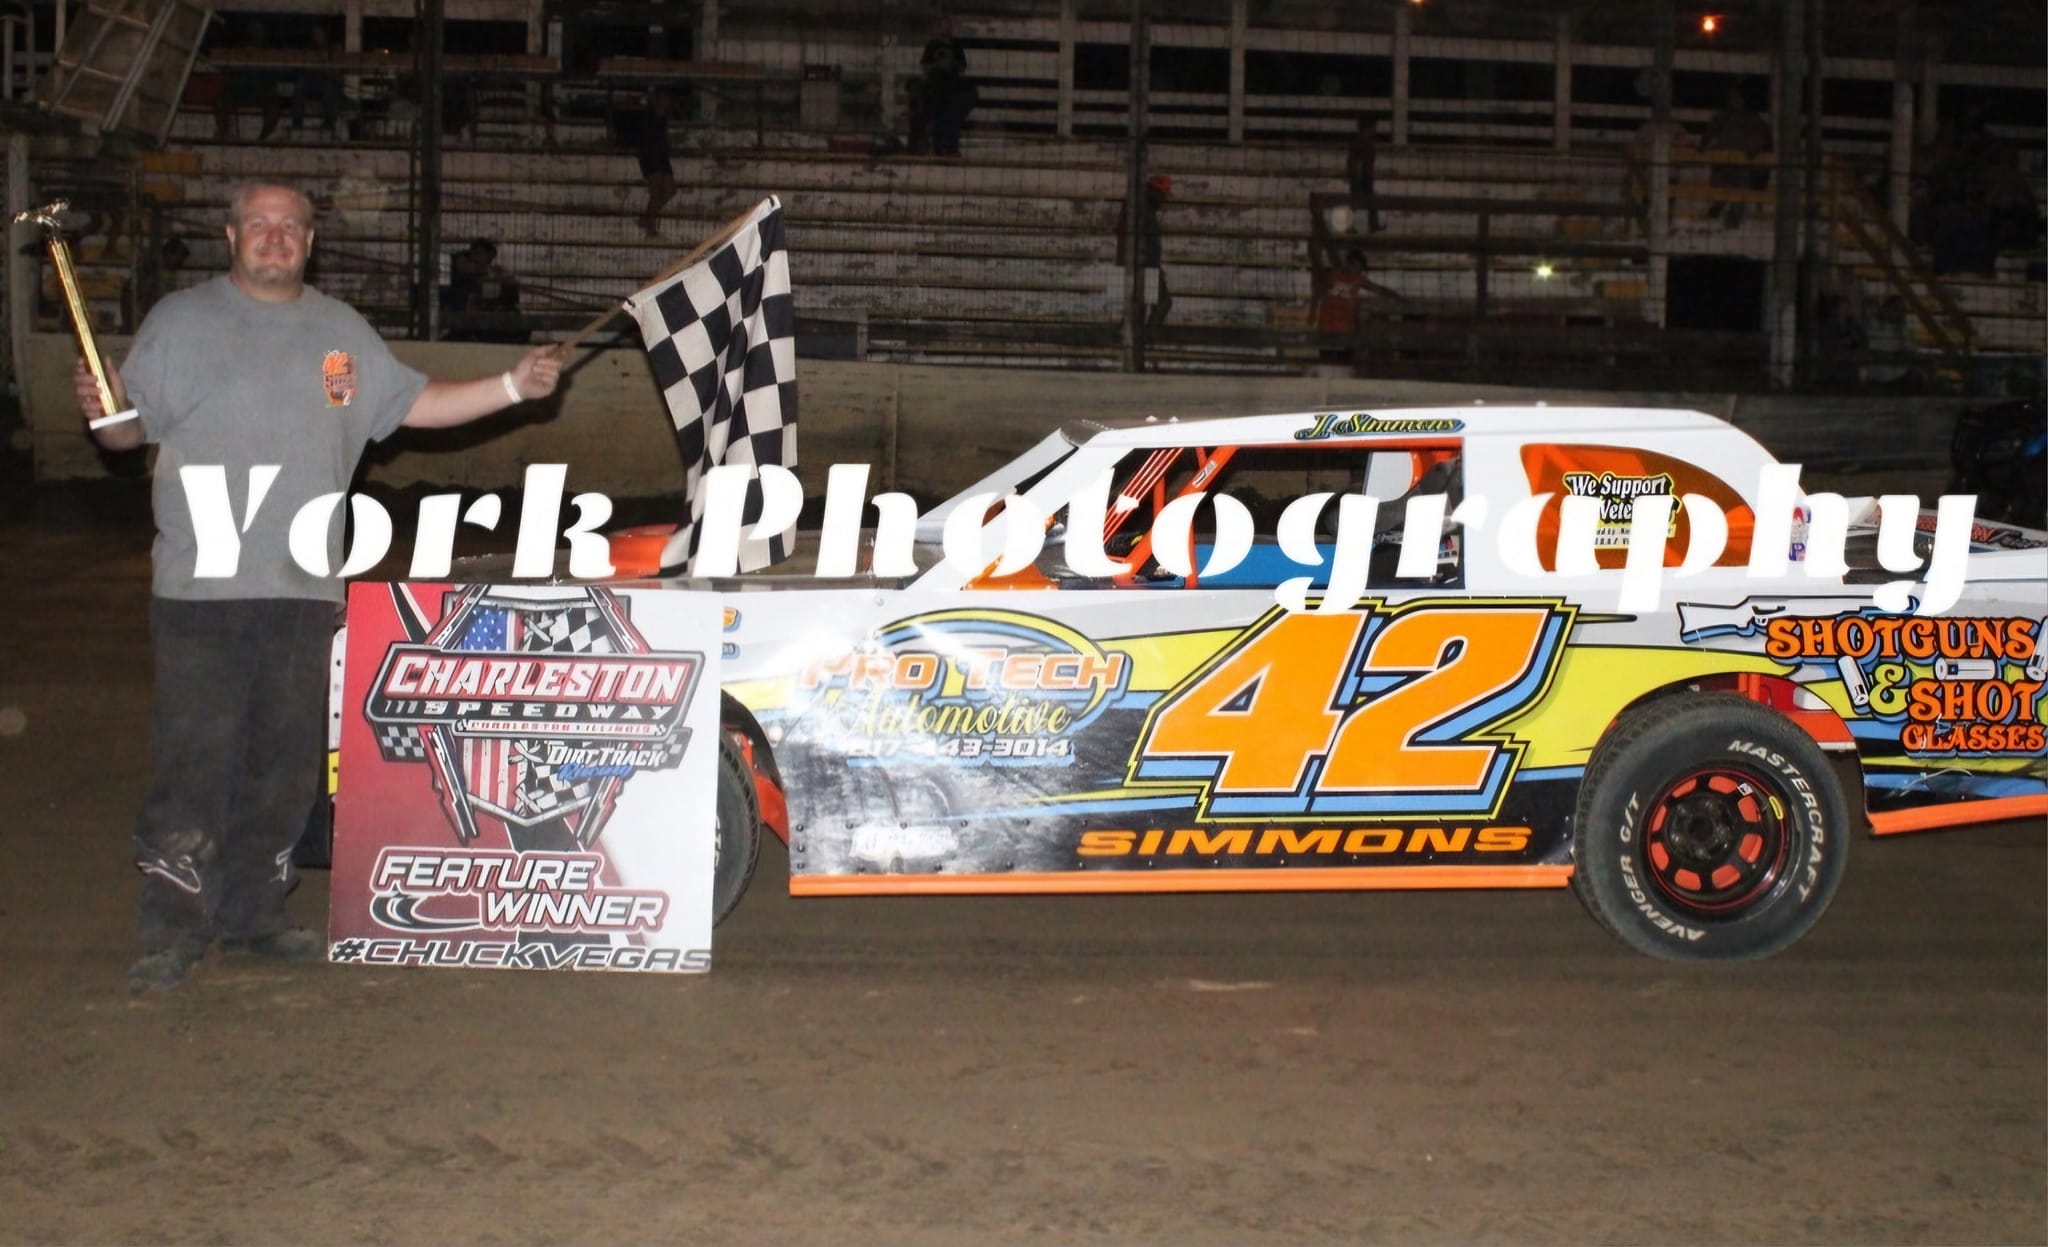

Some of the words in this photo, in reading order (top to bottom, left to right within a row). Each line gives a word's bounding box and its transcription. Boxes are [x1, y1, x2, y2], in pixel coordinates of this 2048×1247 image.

[1567, 475, 1597, 496] We
[1600, 475, 1666, 498] Support
[1765, 618, 2037, 660] SHOTGUNS
[385, 655, 687, 701] CHARLESTON
[804, 653, 938, 689] PRO
[966, 652, 1123, 689] TECH
[1144, 608, 1550, 792] 42
[1869, 664, 1906, 715] &
[1908, 680, 2044, 721] SHOT
[423, 703, 674, 721] SPEEDWAY
[1902, 724, 2047, 751] GLASSES
[1619, 792, 1640, 843] G/T
[1728, 740, 1822, 901] MASTERCRAFT
[1077, 826, 1532, 856] SIMMONS
[374, 854, 599, 891] FEATURE
[485, 892, 665, 927] WINNER
[1620, 855, 1706, 942] AVENGER
[329, 938, 713, 973] #CHUCKVEGAS
